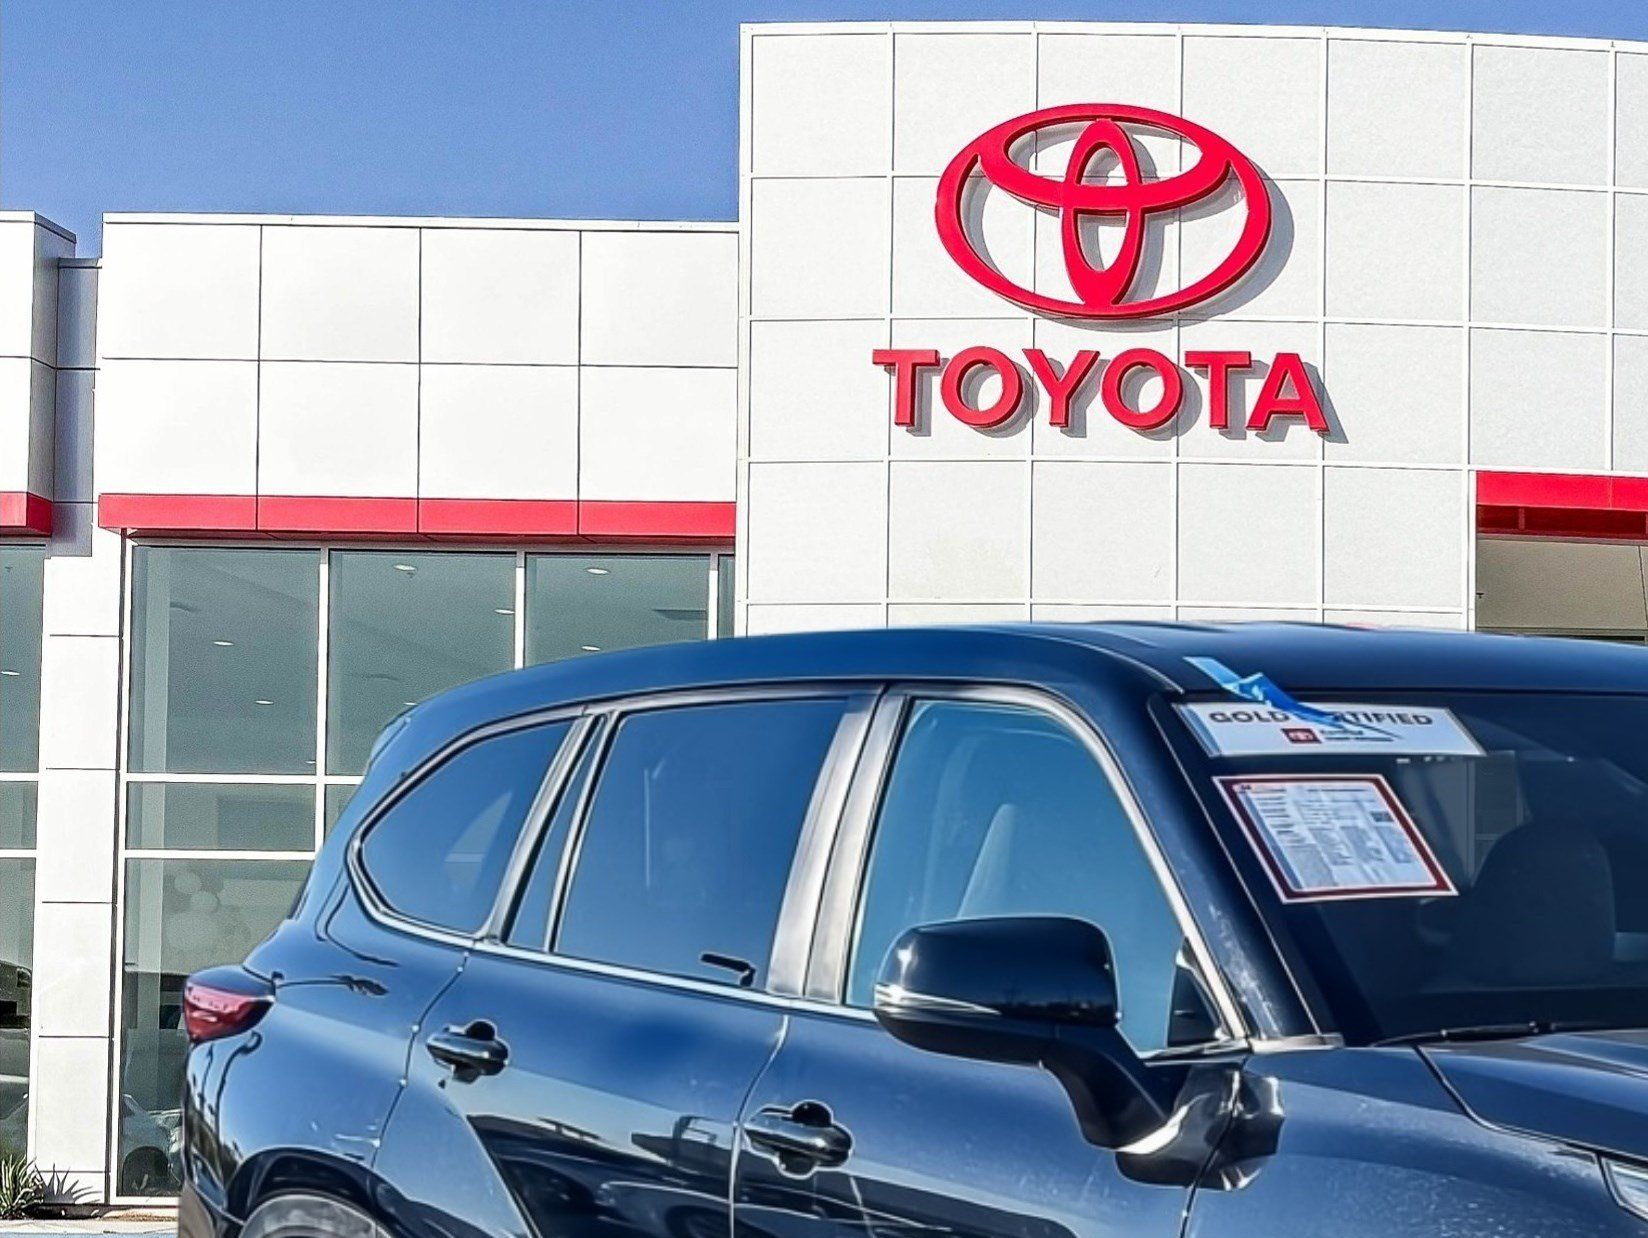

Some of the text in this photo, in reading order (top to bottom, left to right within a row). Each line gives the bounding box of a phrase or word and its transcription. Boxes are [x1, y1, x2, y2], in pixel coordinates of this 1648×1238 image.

[873, 345, 1329, 433] TOYOTA
[1209, 710, 1434, 726] GOLD RTIFIED
